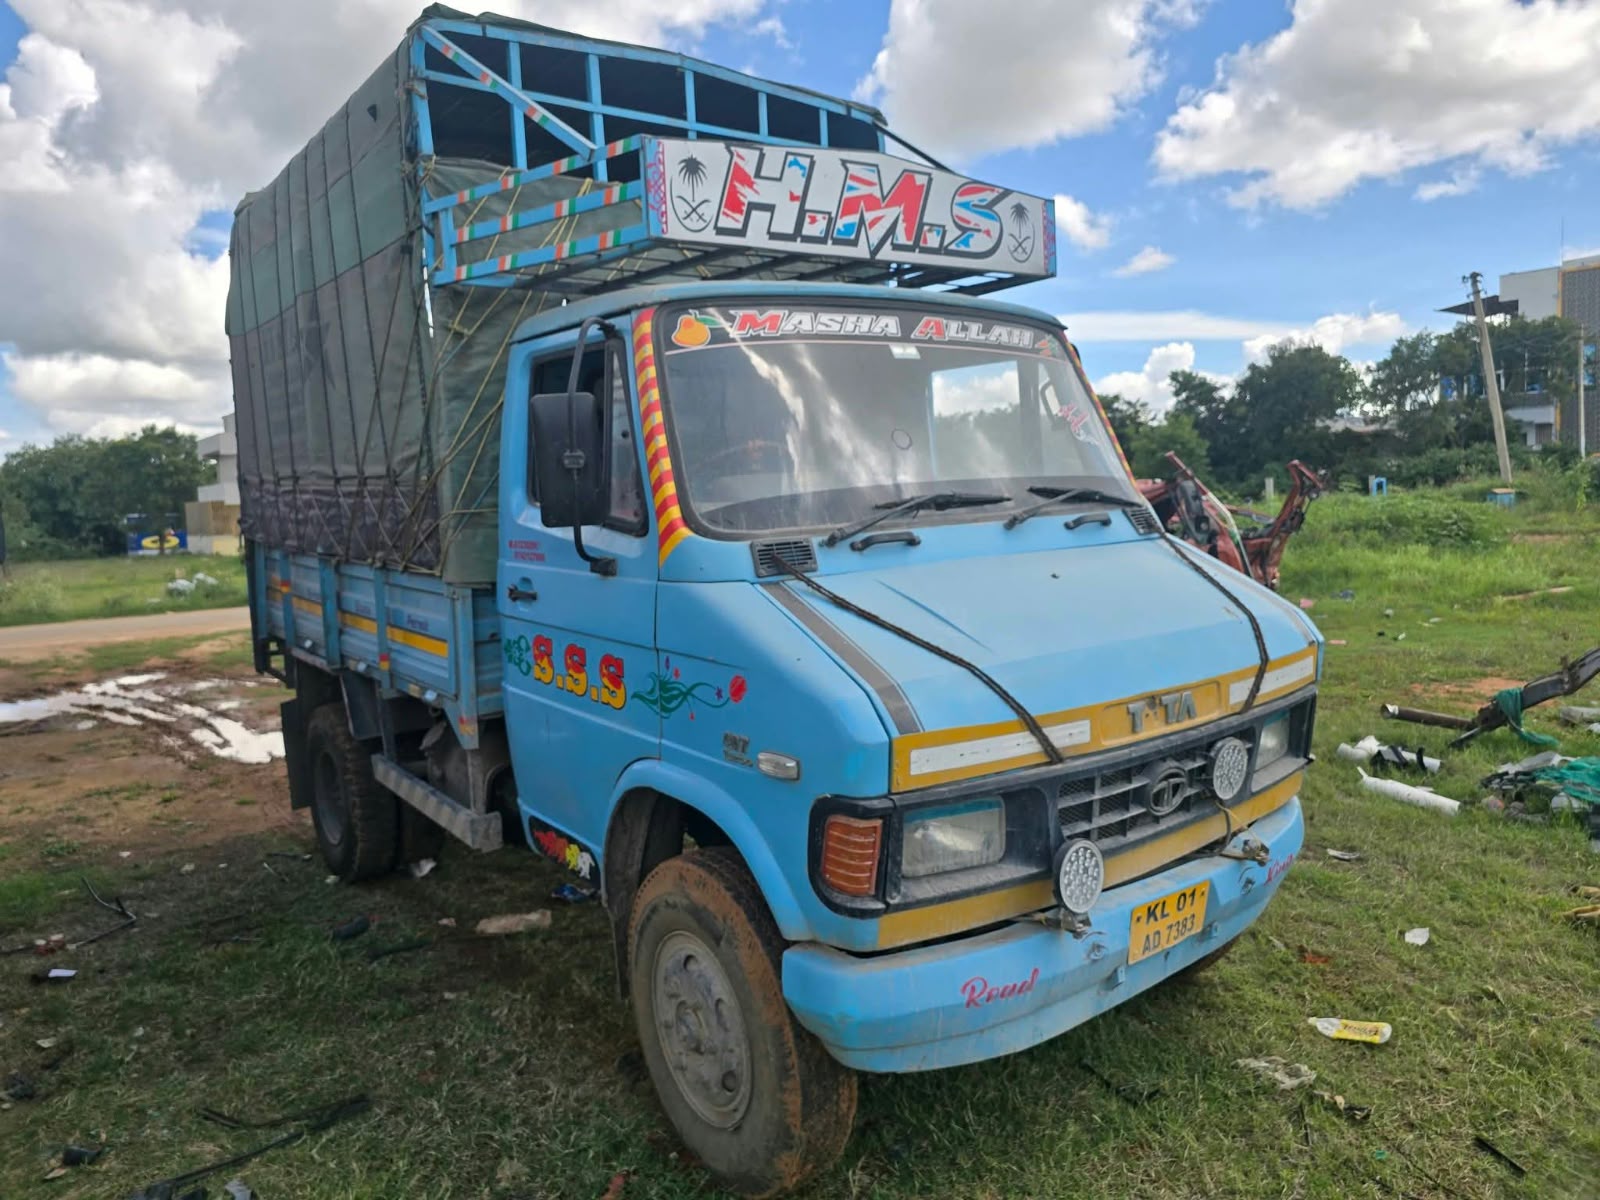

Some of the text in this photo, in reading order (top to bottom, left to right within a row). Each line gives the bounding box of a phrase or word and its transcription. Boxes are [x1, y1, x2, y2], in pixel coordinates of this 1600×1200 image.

[714, 143, 1015, 260] H.M.S
[729, 310, 1034, 349] MASHA ALLAH
[532, 634, 627, 710] S.S.S
[1146, 887, 1197, 925] KL 01
[1142, 913, 1195, 955] AD 7383
[961, 967, 1040, 1009] Road
